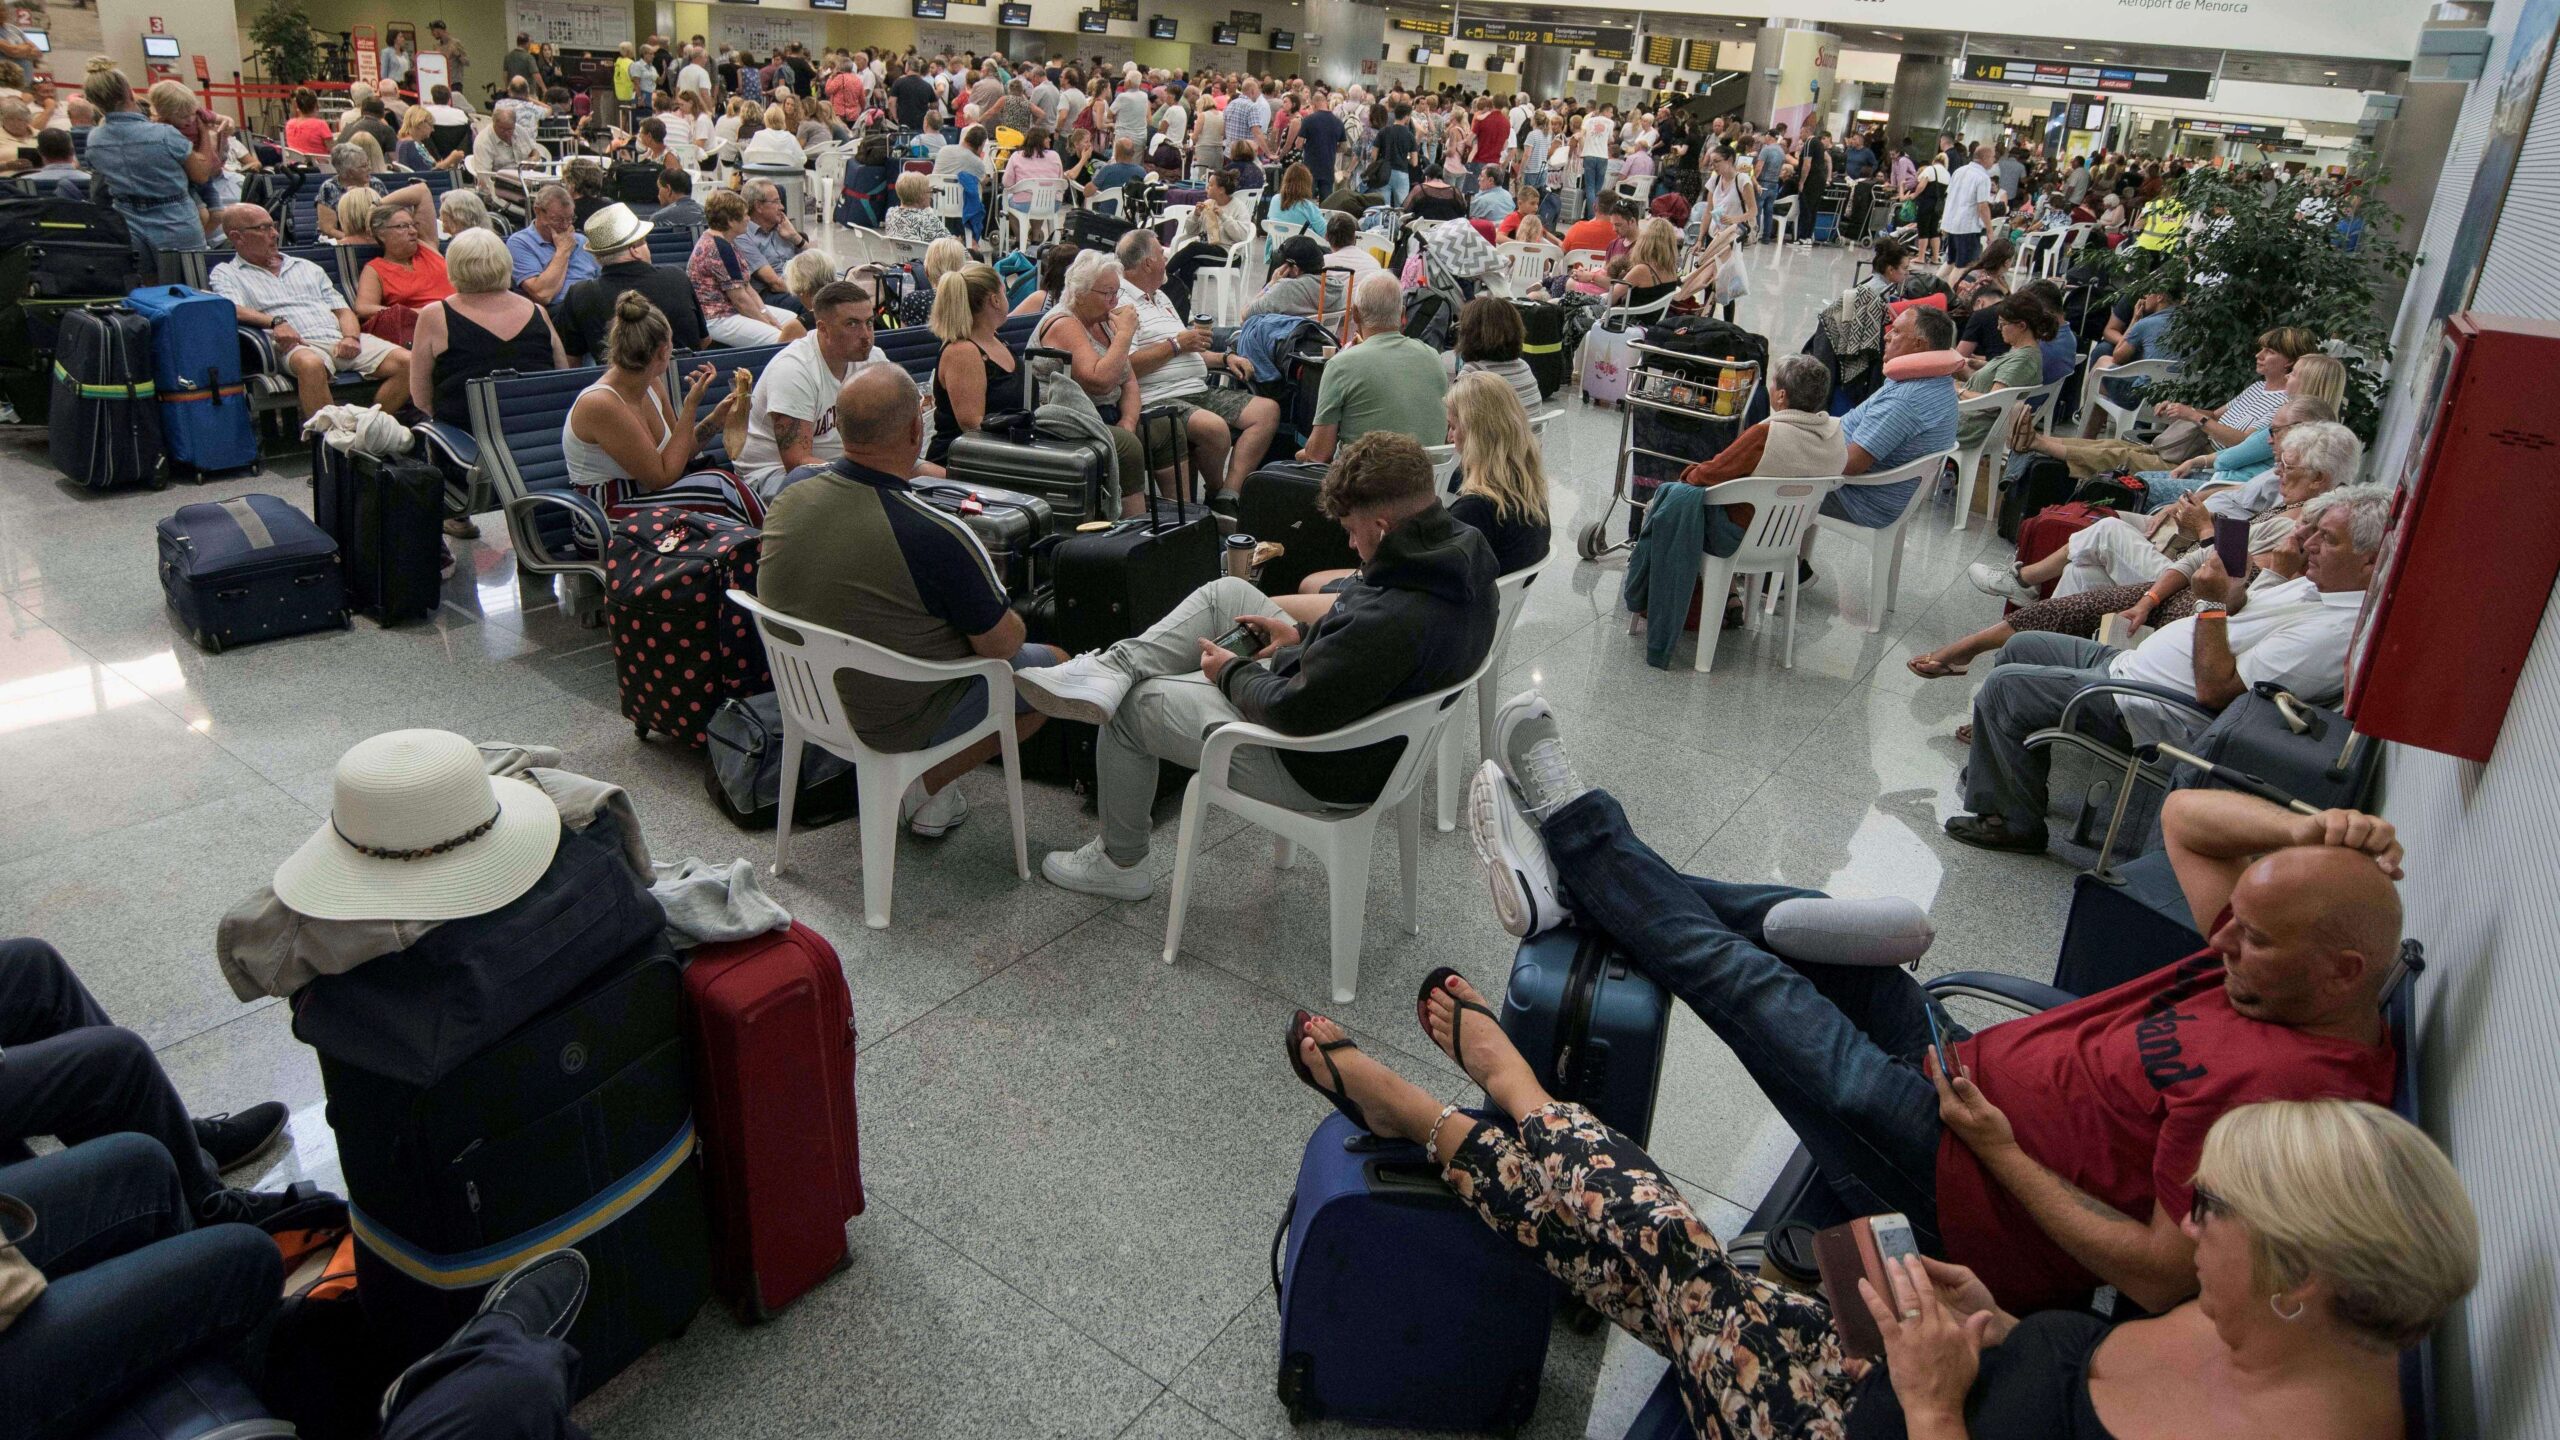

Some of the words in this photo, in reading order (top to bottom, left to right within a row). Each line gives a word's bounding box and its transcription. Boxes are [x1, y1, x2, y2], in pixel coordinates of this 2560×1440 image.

[2175, 0, 2191, 10] de
[2194, 0, 2248, 13] Menorca
[18, 10, 31, 25] 2
[151, 18, 163, 32] 3
